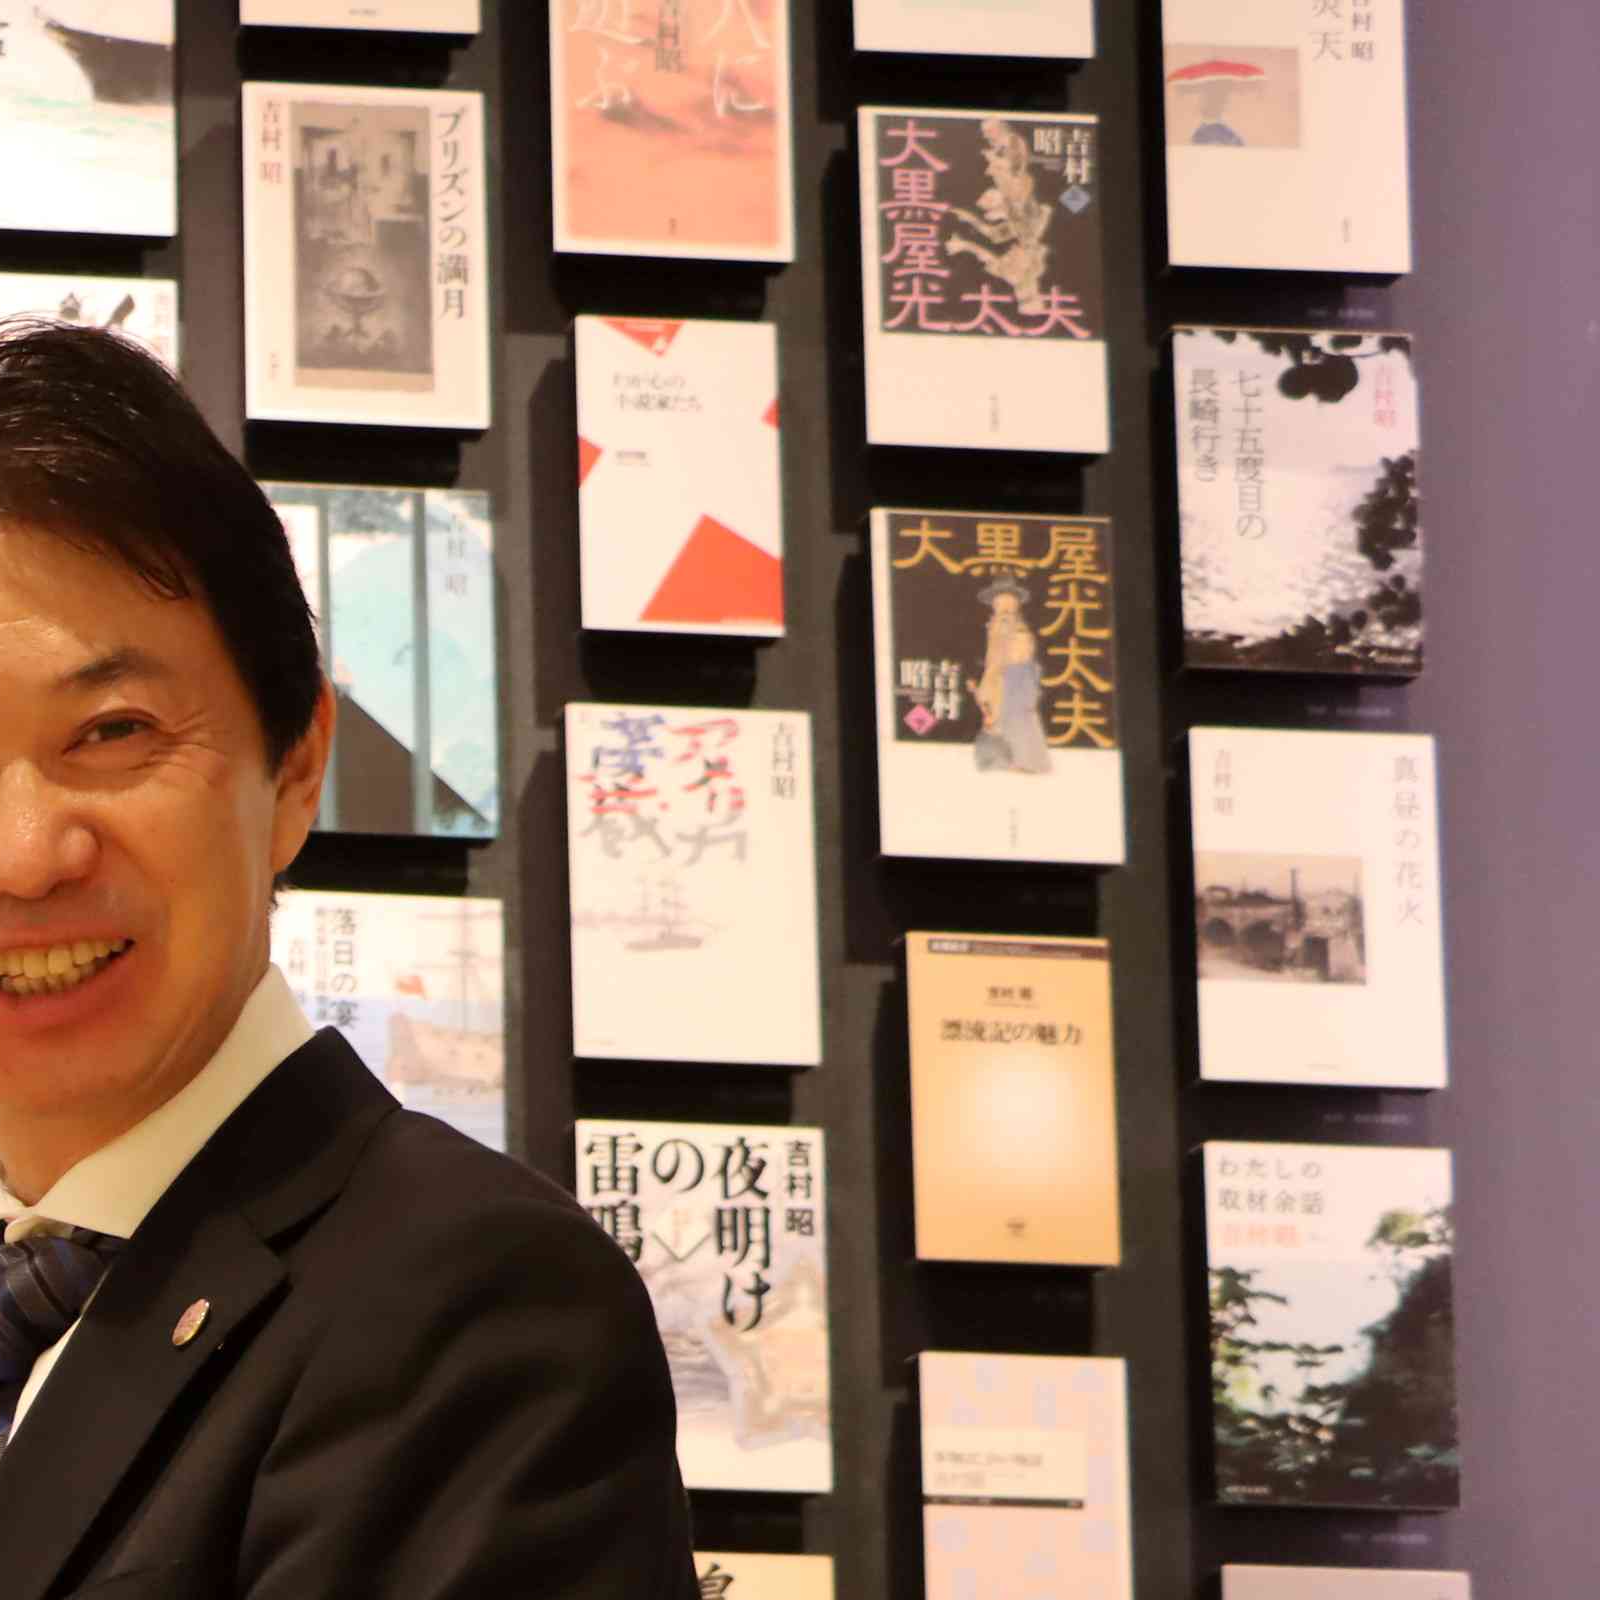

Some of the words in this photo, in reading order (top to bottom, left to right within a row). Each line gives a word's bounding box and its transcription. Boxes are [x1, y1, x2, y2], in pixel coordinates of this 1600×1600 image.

[436, 106, 470, 321] プリズンの満月
[1234, 369, 1266, 539] 七十五度目の
[652, 1138, 705, 1193] の
[713, 1136, 771, 1332] 夜明け
[785, 1140, 814, 1238] 吉村昭
